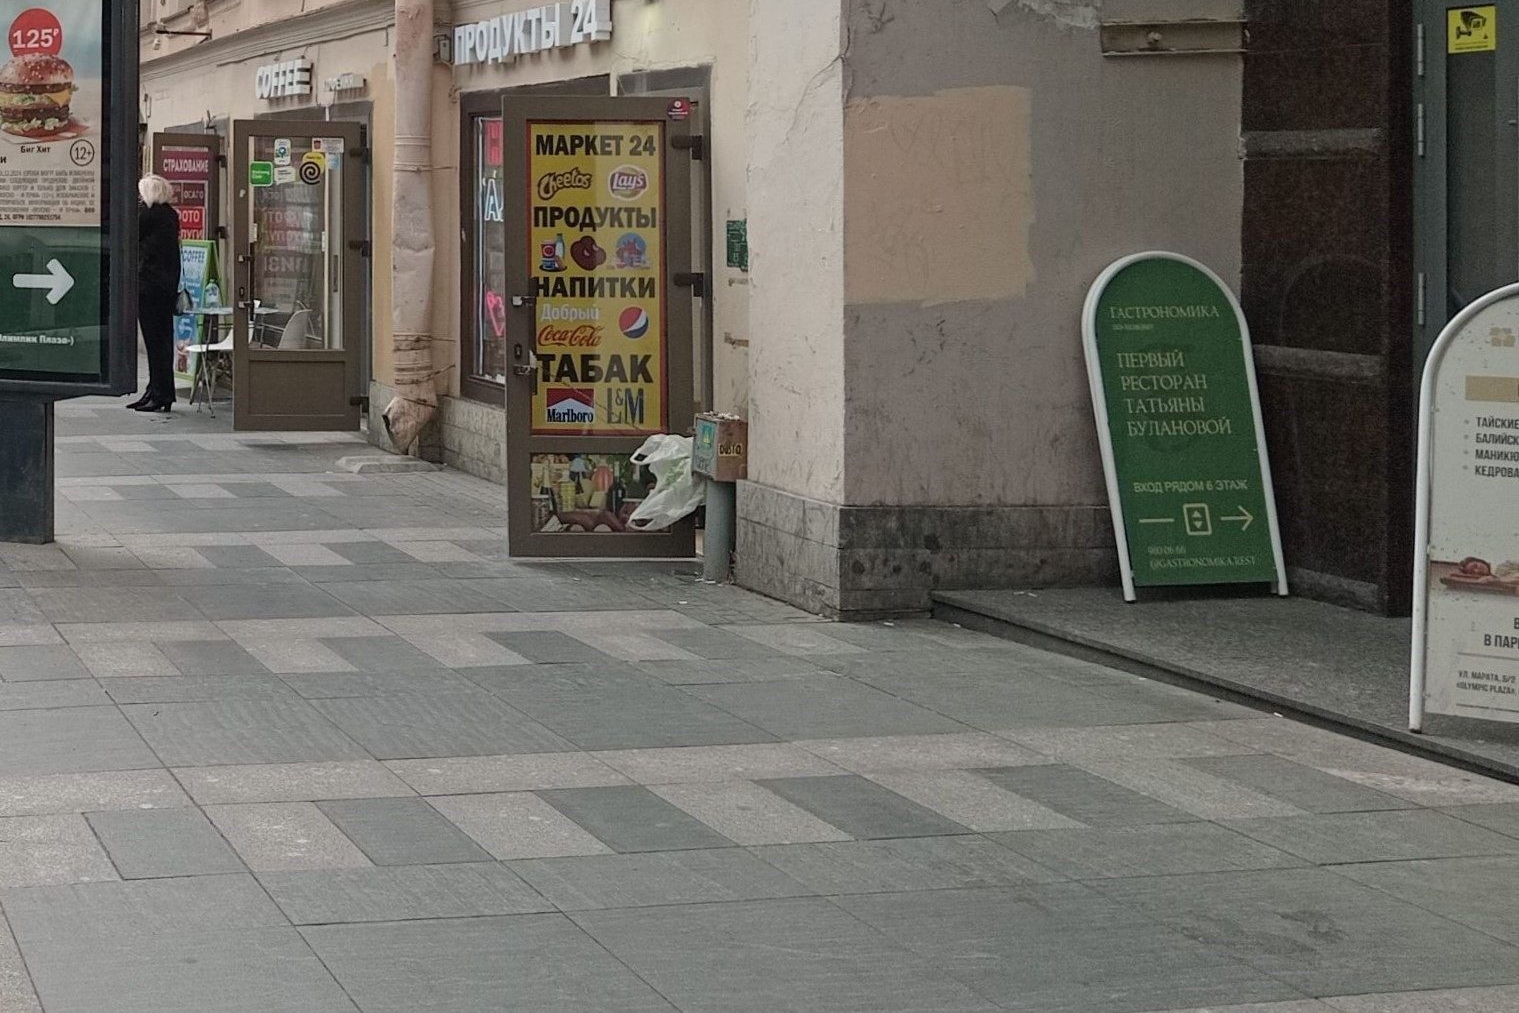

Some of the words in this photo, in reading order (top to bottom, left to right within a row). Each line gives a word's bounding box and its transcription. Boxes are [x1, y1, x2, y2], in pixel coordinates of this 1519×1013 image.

[454, 1, 561, 65] ПРОДУКТЫ
[255, 58, 310, 99] COFFEE
[20, 145, 35, 154] Биг
[36, 145, 51, 154] Хит
[74, 146, 92, 161] 12+
[535, 134, 624, 156] МАРКЕТ
[628, 134, 657, 156] 24
[162, 158, 209, 174] СТРАХОВАНИЕ
[537, 167, 593, 201] Cheetos
[178, 209, 200, 223] ОТО
[533, 206, 657, 233] ПРОДУКТЫ
[533, 276, 656, 299] НАПИТКИ
[541, 303, 600, 322] Добрый
[1109, 305, 1220, 319] ГАСТРОНОМИКА
[538, 324, 603, 347] Coca-Cola
[1117, 348, 1185, 368] ПЕРВЫЙ
[535, 353, 654, 383] ТАБАК
[1120, 373, 1208, 391] РЕСТОРАН
[607, 387, 644, 425] L&M
[1123, 396, 1205, 415] ТАТЬЯНЫ
[546, 408, 594, 423] Marlboro
[1476, 415, 1519, 429] ТАЙСКИЕ
[1126, 415, 1232, 437] БУЛАНОВОЙ
[1133, 481, 1164, 494] ВХОД
[1164, 480, 1204, 493] РЯДОМ
[1206, 480, 1214, 491] 6
[1215, 479, 1248, 491] ЭТАЖ
[1484, 633, 1492, 646] В
[1494, 634, 1519, 650] ПАР
